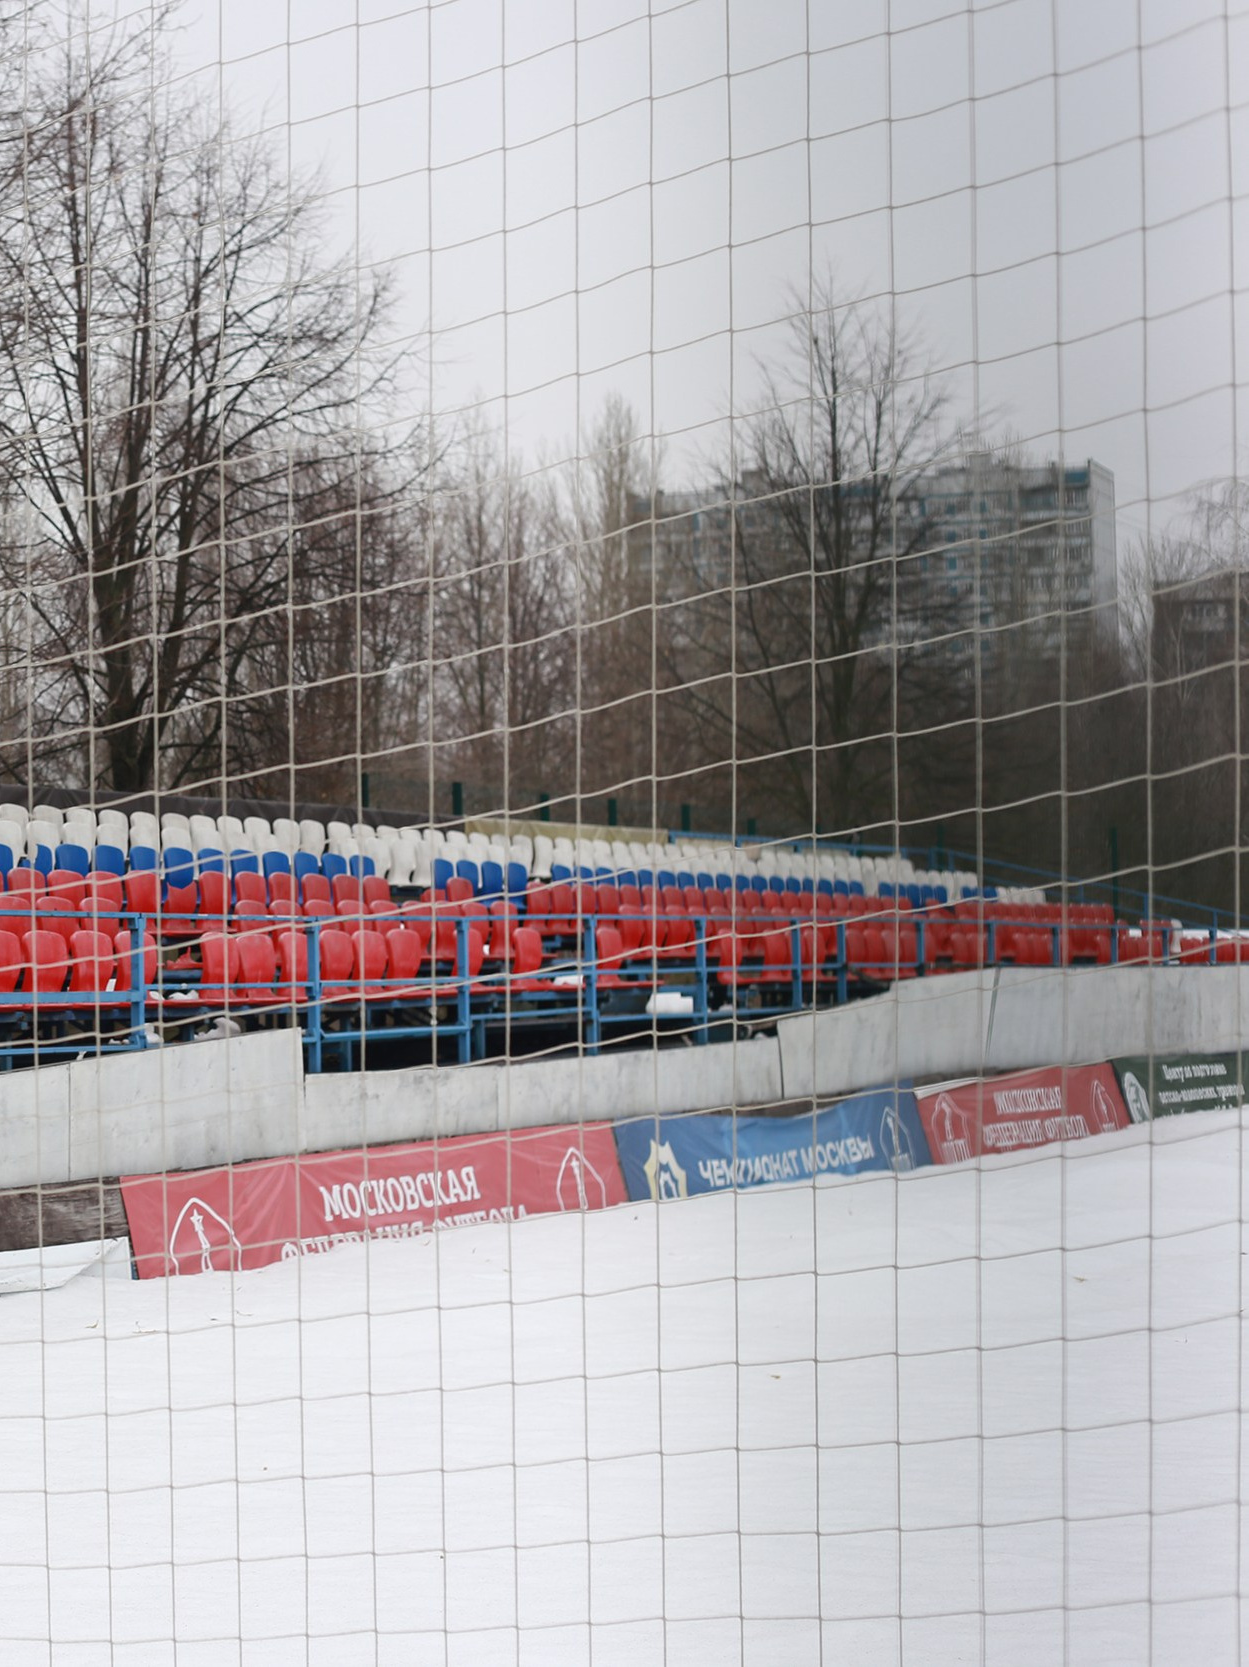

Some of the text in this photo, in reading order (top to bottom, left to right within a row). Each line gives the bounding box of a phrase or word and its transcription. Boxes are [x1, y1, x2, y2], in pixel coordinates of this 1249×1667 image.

[698, 1149, 799, 1188] ЧЕМПИОНАТ
[800, 1134, 875, 1174] МОСКВЫ
[318, 1166, 481, 1222] МОСКОВСКАЯ
